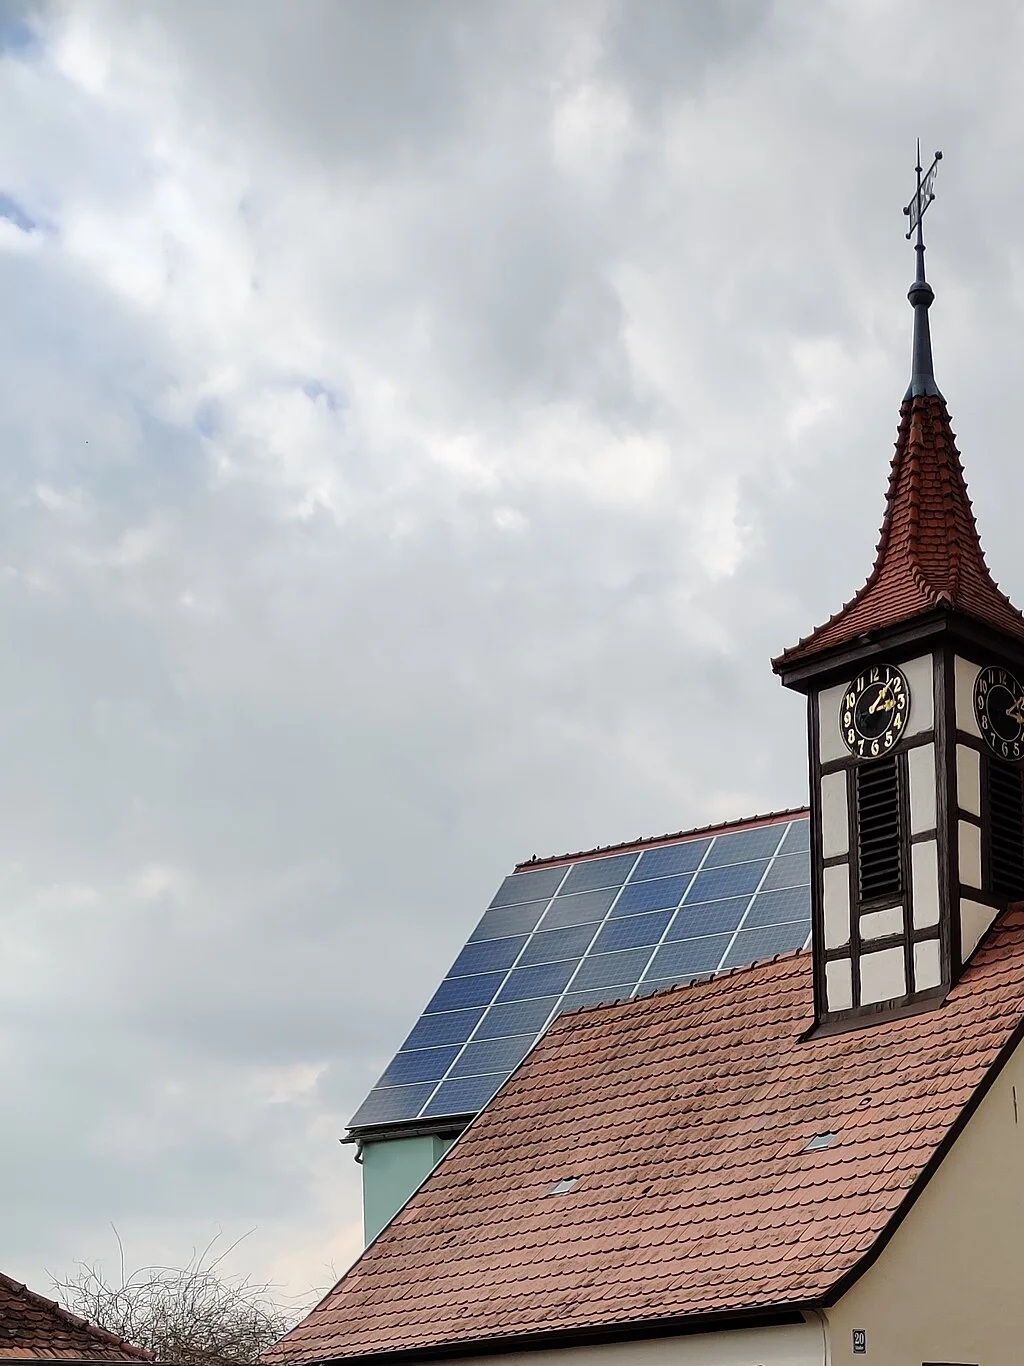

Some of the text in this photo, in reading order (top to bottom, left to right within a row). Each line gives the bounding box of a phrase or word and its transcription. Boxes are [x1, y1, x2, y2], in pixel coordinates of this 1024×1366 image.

[871, 667, 879, 683] 12
[886, 668, 890, 683] 1
[988, 670, 994, 684] 11
[999, 670, 1007, 685] 12
[857, 677, 864, 692] 11
[894, 677, 902, 693] 2
[980, 679, 987, 694] 10
[846, 692, 855, 710] 10
[897, 694, 905, 709] 3
[978, 696, 984, 710] 9
[844, 712, 851, 728] 9
[893, 713, 902, 729] 4
[982, 715, 988, 730] 8
[848, 729, 855, 744] 8
[884, 730, 892, 747] 5
[990, 732, 996, 747] 7
[858, 739, 864, 755] 7
[871, 740, 879, 755] 6
[1002, 742, 1008, 757] 6
[1013, 742, 1020, 756] 5
[855, 1332, 864, 1344] 20
